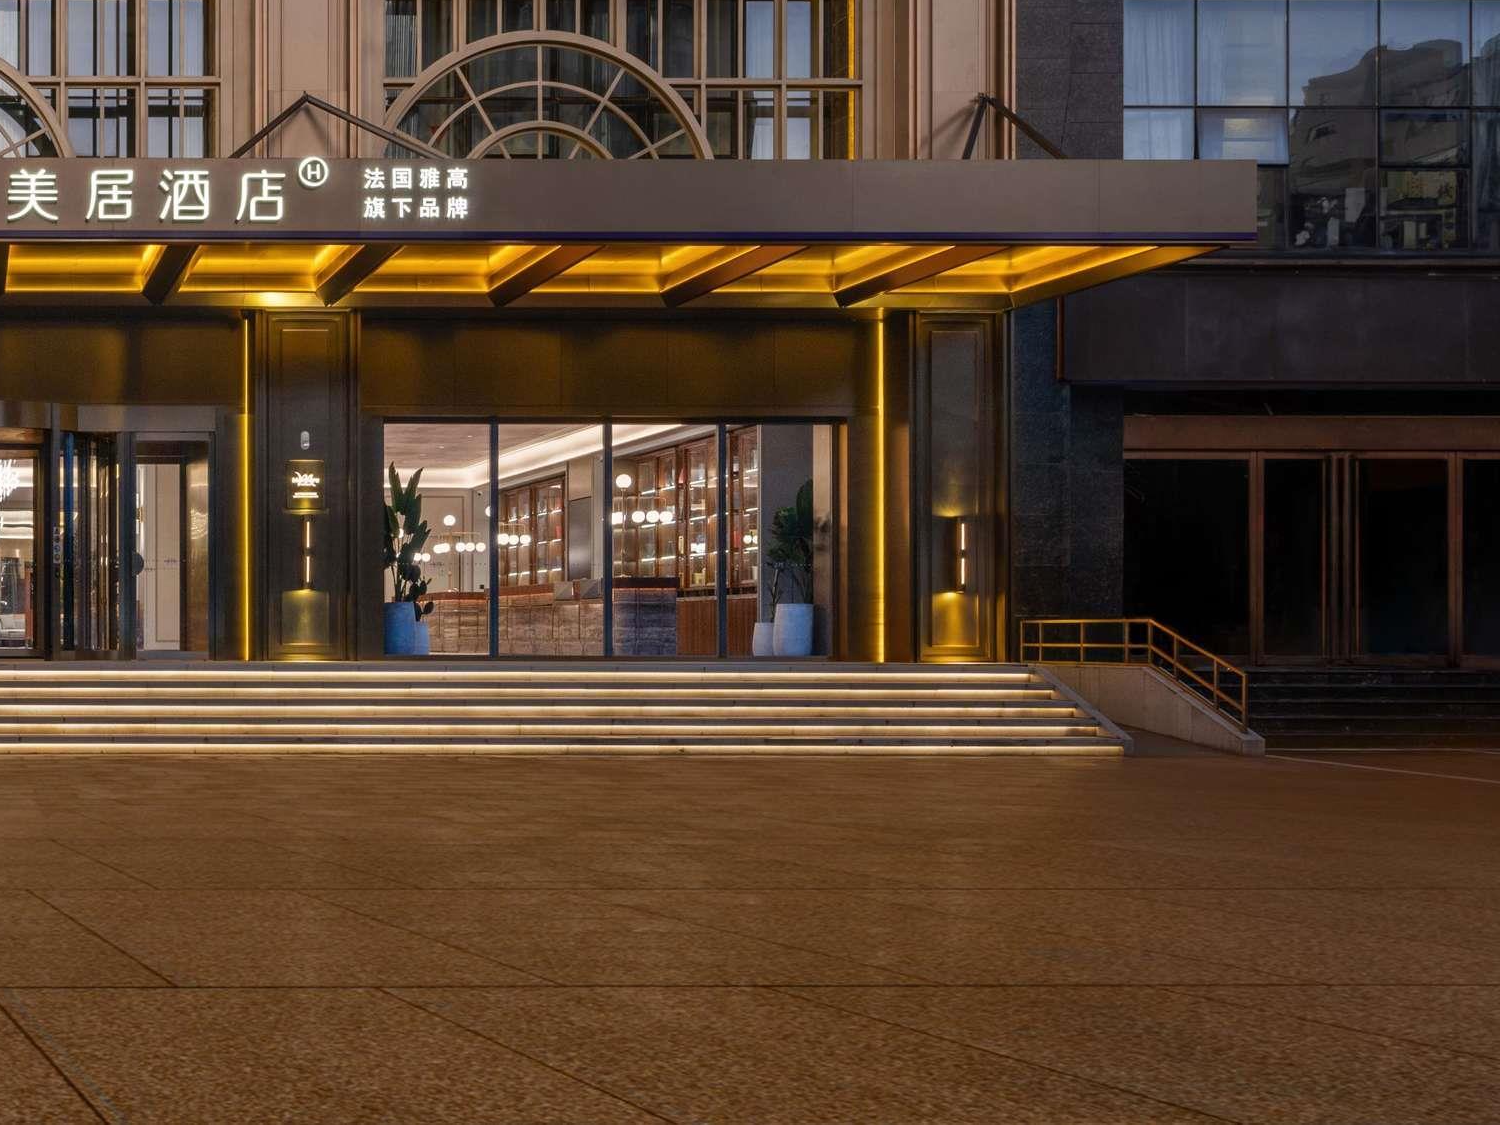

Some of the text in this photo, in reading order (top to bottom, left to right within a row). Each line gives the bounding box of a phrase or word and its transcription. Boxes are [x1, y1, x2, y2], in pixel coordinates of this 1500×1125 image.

[363, 167, 468, 190] 法国雅高
[7, 168, 286, 220] 美居酒店
[363, 196, 468, 219] 旗下品牌
